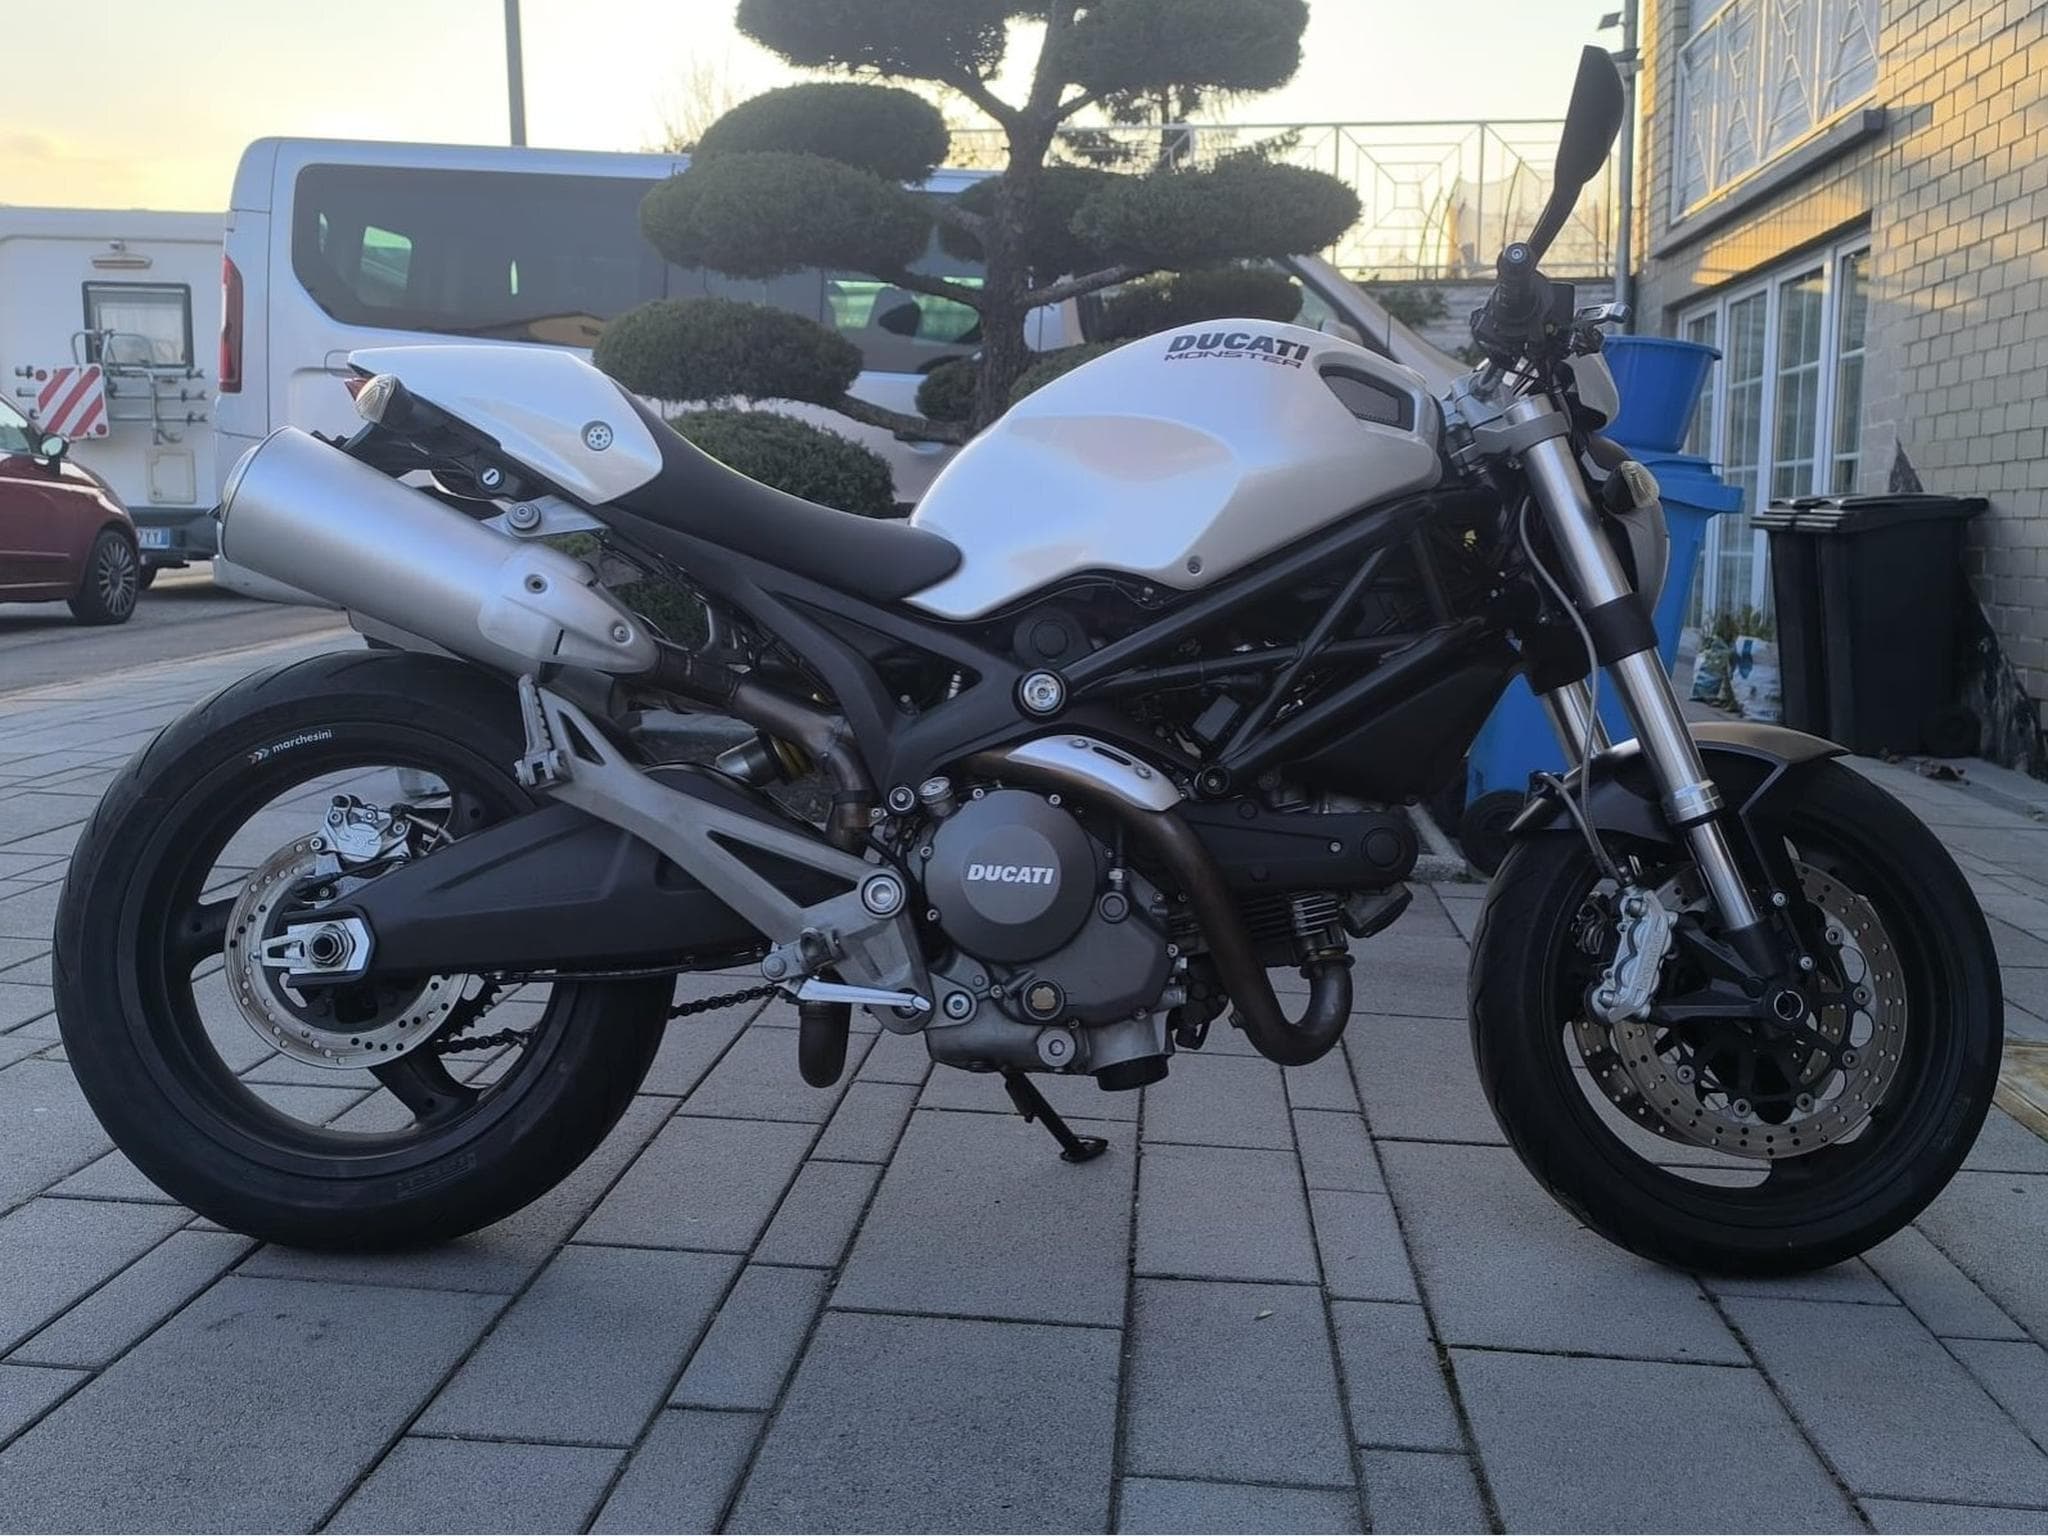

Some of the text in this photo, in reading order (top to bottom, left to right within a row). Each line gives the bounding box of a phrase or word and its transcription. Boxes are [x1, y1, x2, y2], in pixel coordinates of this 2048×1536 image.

[1168, 332, 1310, 362] DUCATI
[1164, 350, 1303, 369] MONSTER
[272, 729, 333, 753] marchesini
[967, 864, 1055, 885] DUCATI
